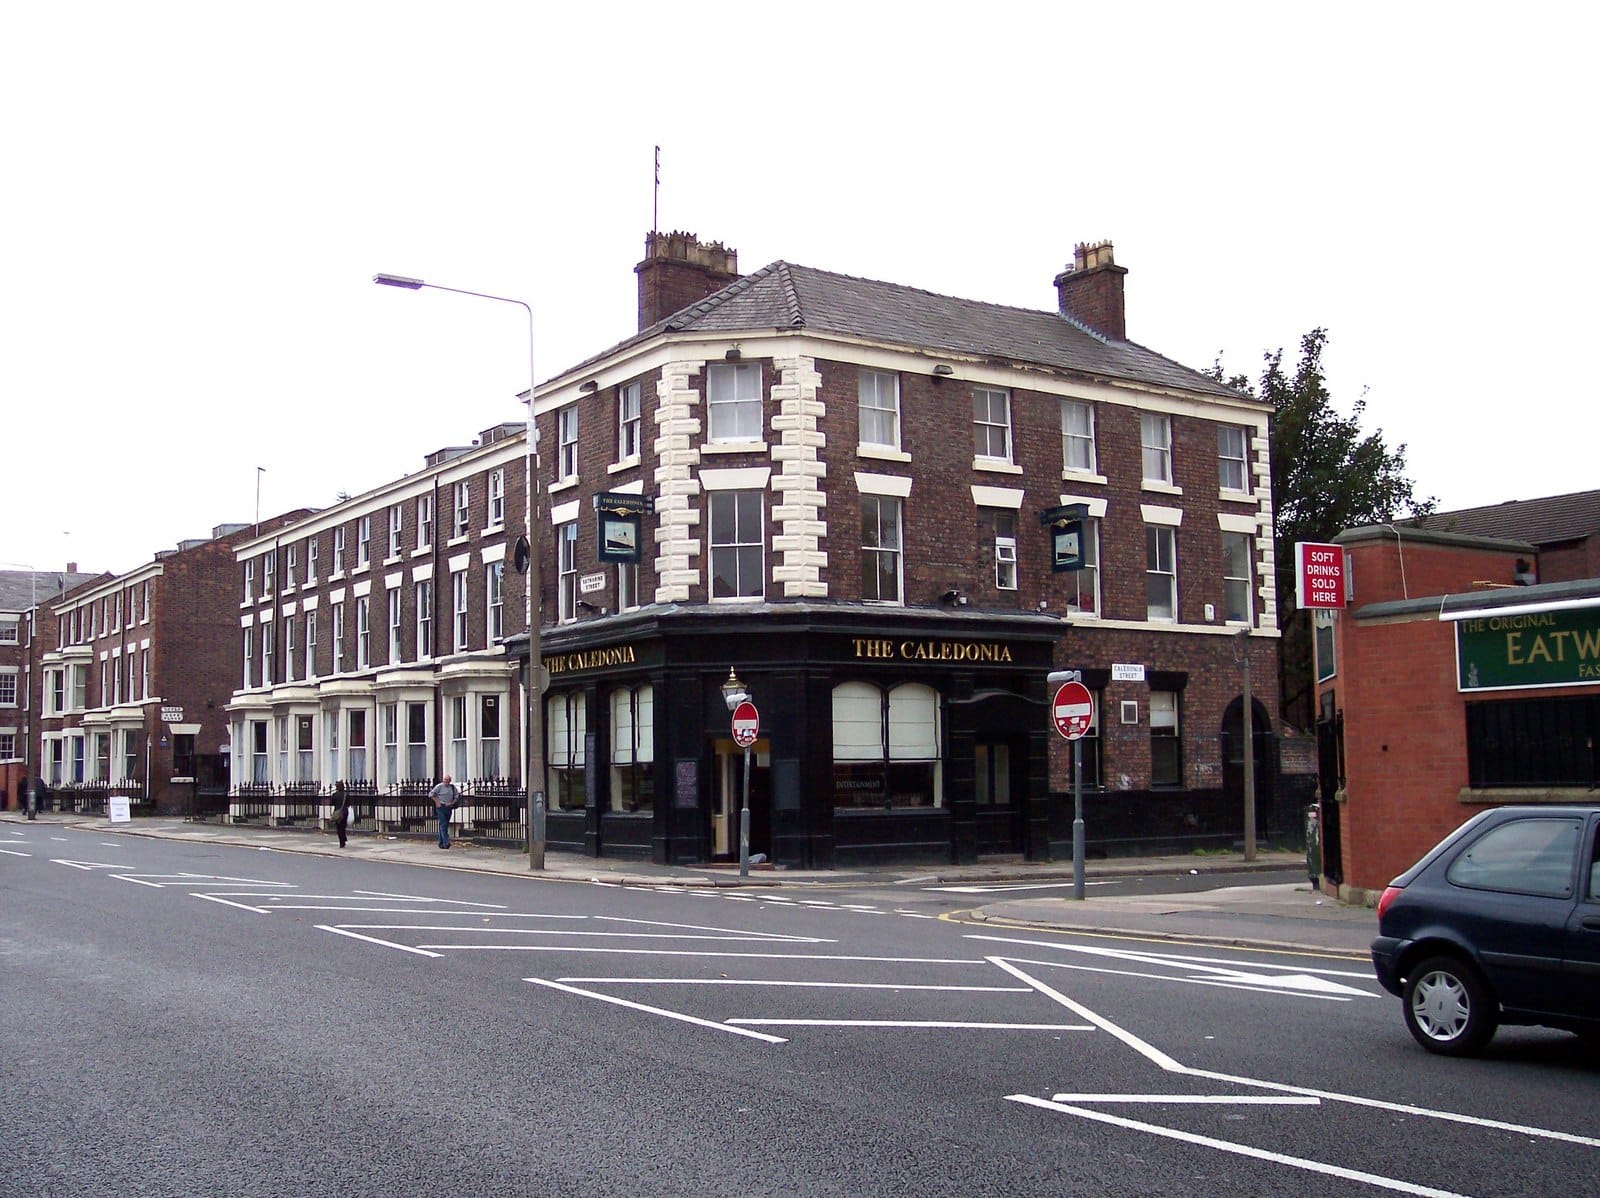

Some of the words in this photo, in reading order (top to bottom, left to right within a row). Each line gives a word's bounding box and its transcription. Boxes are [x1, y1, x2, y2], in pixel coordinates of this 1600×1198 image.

[1311, 551, 1335, 563] SOFT
[1307, 564, 1340, 577] DRINKS
[1311, 578, 1336, 589] SOLD
[1312, 591, 1337, 602] HERE
[1461, 619, 1485, 633] THE
[1489, 613, 1557, 631] ORIGINAL
[852, 639, 894, 658] THE
[900, 640, 1013, 662] CALEDONIA
[1506, 627, 1600, 665] EATW
[544, 656, 566, 673] THE
[568, 645, 635, 671] CALEDONIA
